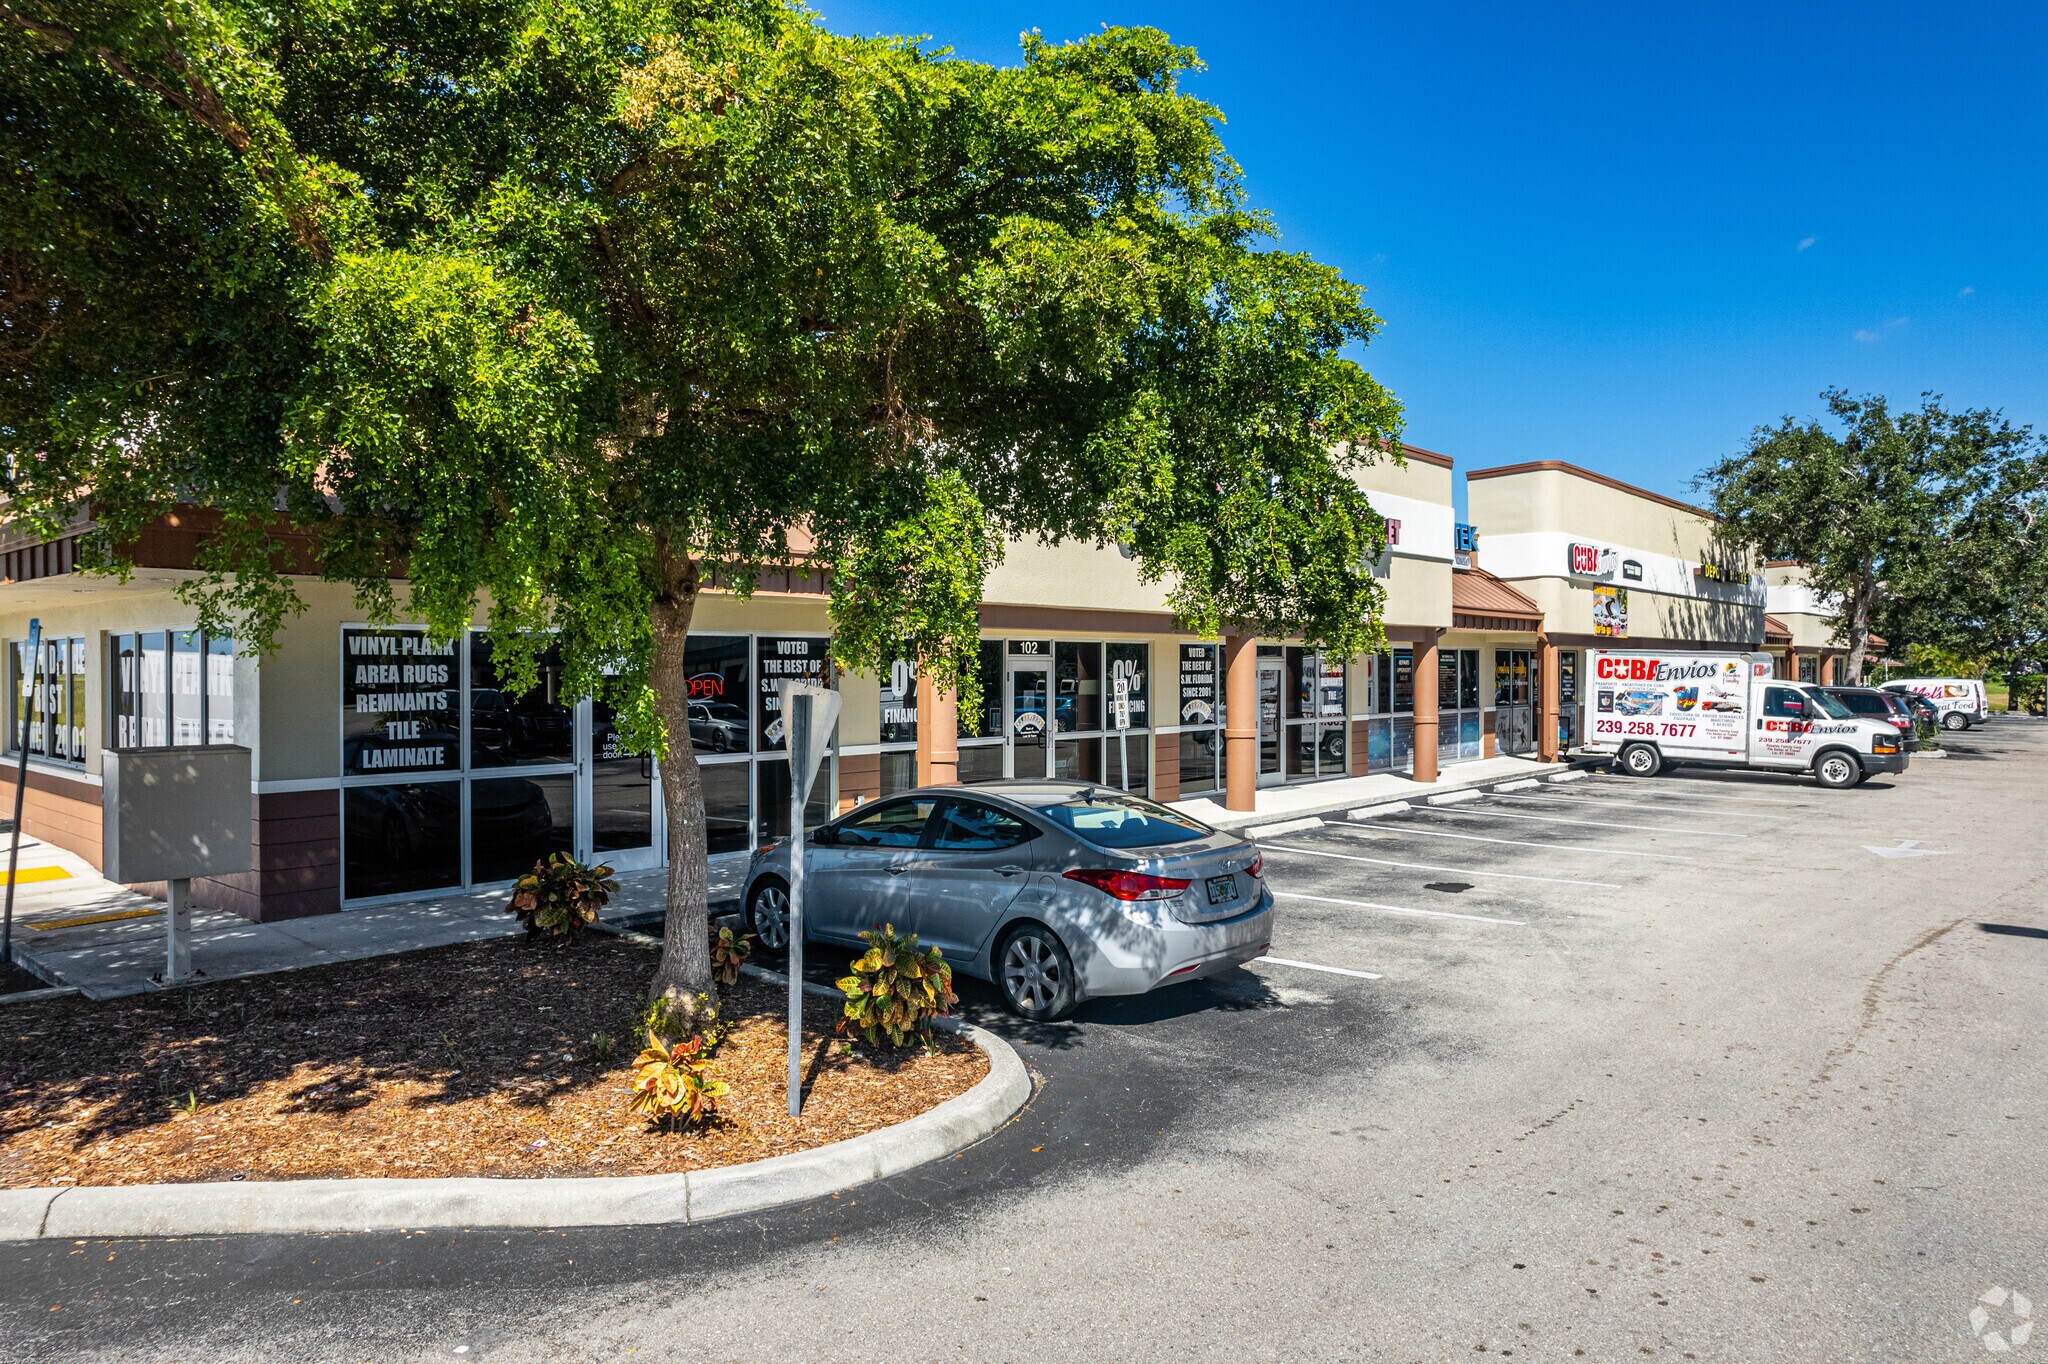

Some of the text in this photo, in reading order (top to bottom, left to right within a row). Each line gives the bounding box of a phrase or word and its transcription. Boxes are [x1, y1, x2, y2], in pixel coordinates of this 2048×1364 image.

[348, 636, 399, 655] VINYL
[777, 641, 808, 654] VOTED
[1020, 641, 1038, 654] 102
[1188, 647, 1205, 658] VOTED
[763, 659, 821, 673] THE BEST OF
[1181, 661, 1212, 671] THE BEST OF
[1597, 658, 1719, 682] CUBA Envios
[355, 664, 448, 683] AREA RUGS
[1192, 674, 1213, 684] FLORIDA
[684, 679, 724, 696] OPEN
[1182, 687, 1211, 697] SINCE 2001
[1912, 685, 1943, 699] Mel's
[356, 692, 447, 713] REMNANTS
[765, 697, 781, 711] SIN
[1109, 700, 1145, 713] FICING
[1952, 701, 1974, 709] Food
[386, 721, 420, 740] TILE
[1596, 720, 1697, 738] 239.258.7677
[1811, 723, 1858, 734] Envios
[18, 720, 85, 758] SNC 2001
[607, 733, 634, 741] Plee
[1758, 737, 1812, 745] 239.258.7677
[363, 747, 444, 768] LAMINATE
